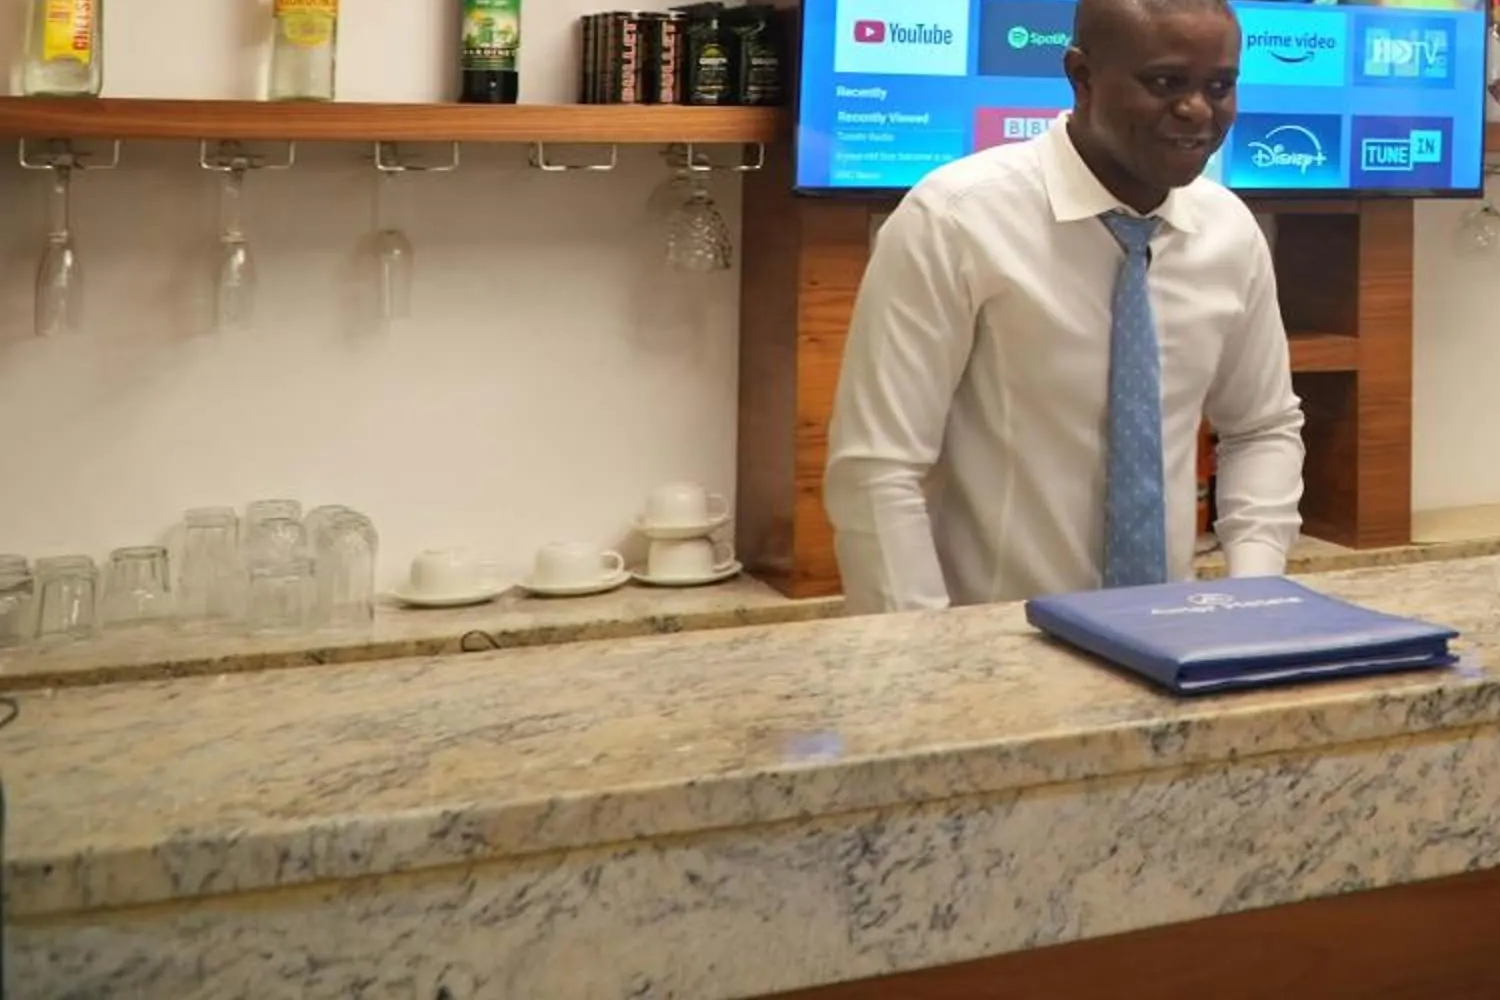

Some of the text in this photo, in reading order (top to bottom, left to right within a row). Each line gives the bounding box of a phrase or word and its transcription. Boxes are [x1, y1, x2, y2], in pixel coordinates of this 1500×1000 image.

[888, 22, 954, 46] YouTube
[1029, 31, 1071, 48] Spotify
[1247, 31, 1335, 50] prime video
[622, 19, 637, 103] BULLET
[660, 21, 676, 103] BULLET
[836, 85, 888, 102] Recently
[838, 112, 930, 126] Recently Viewed
[1367, 138, 1435, 164] TUNE IN
